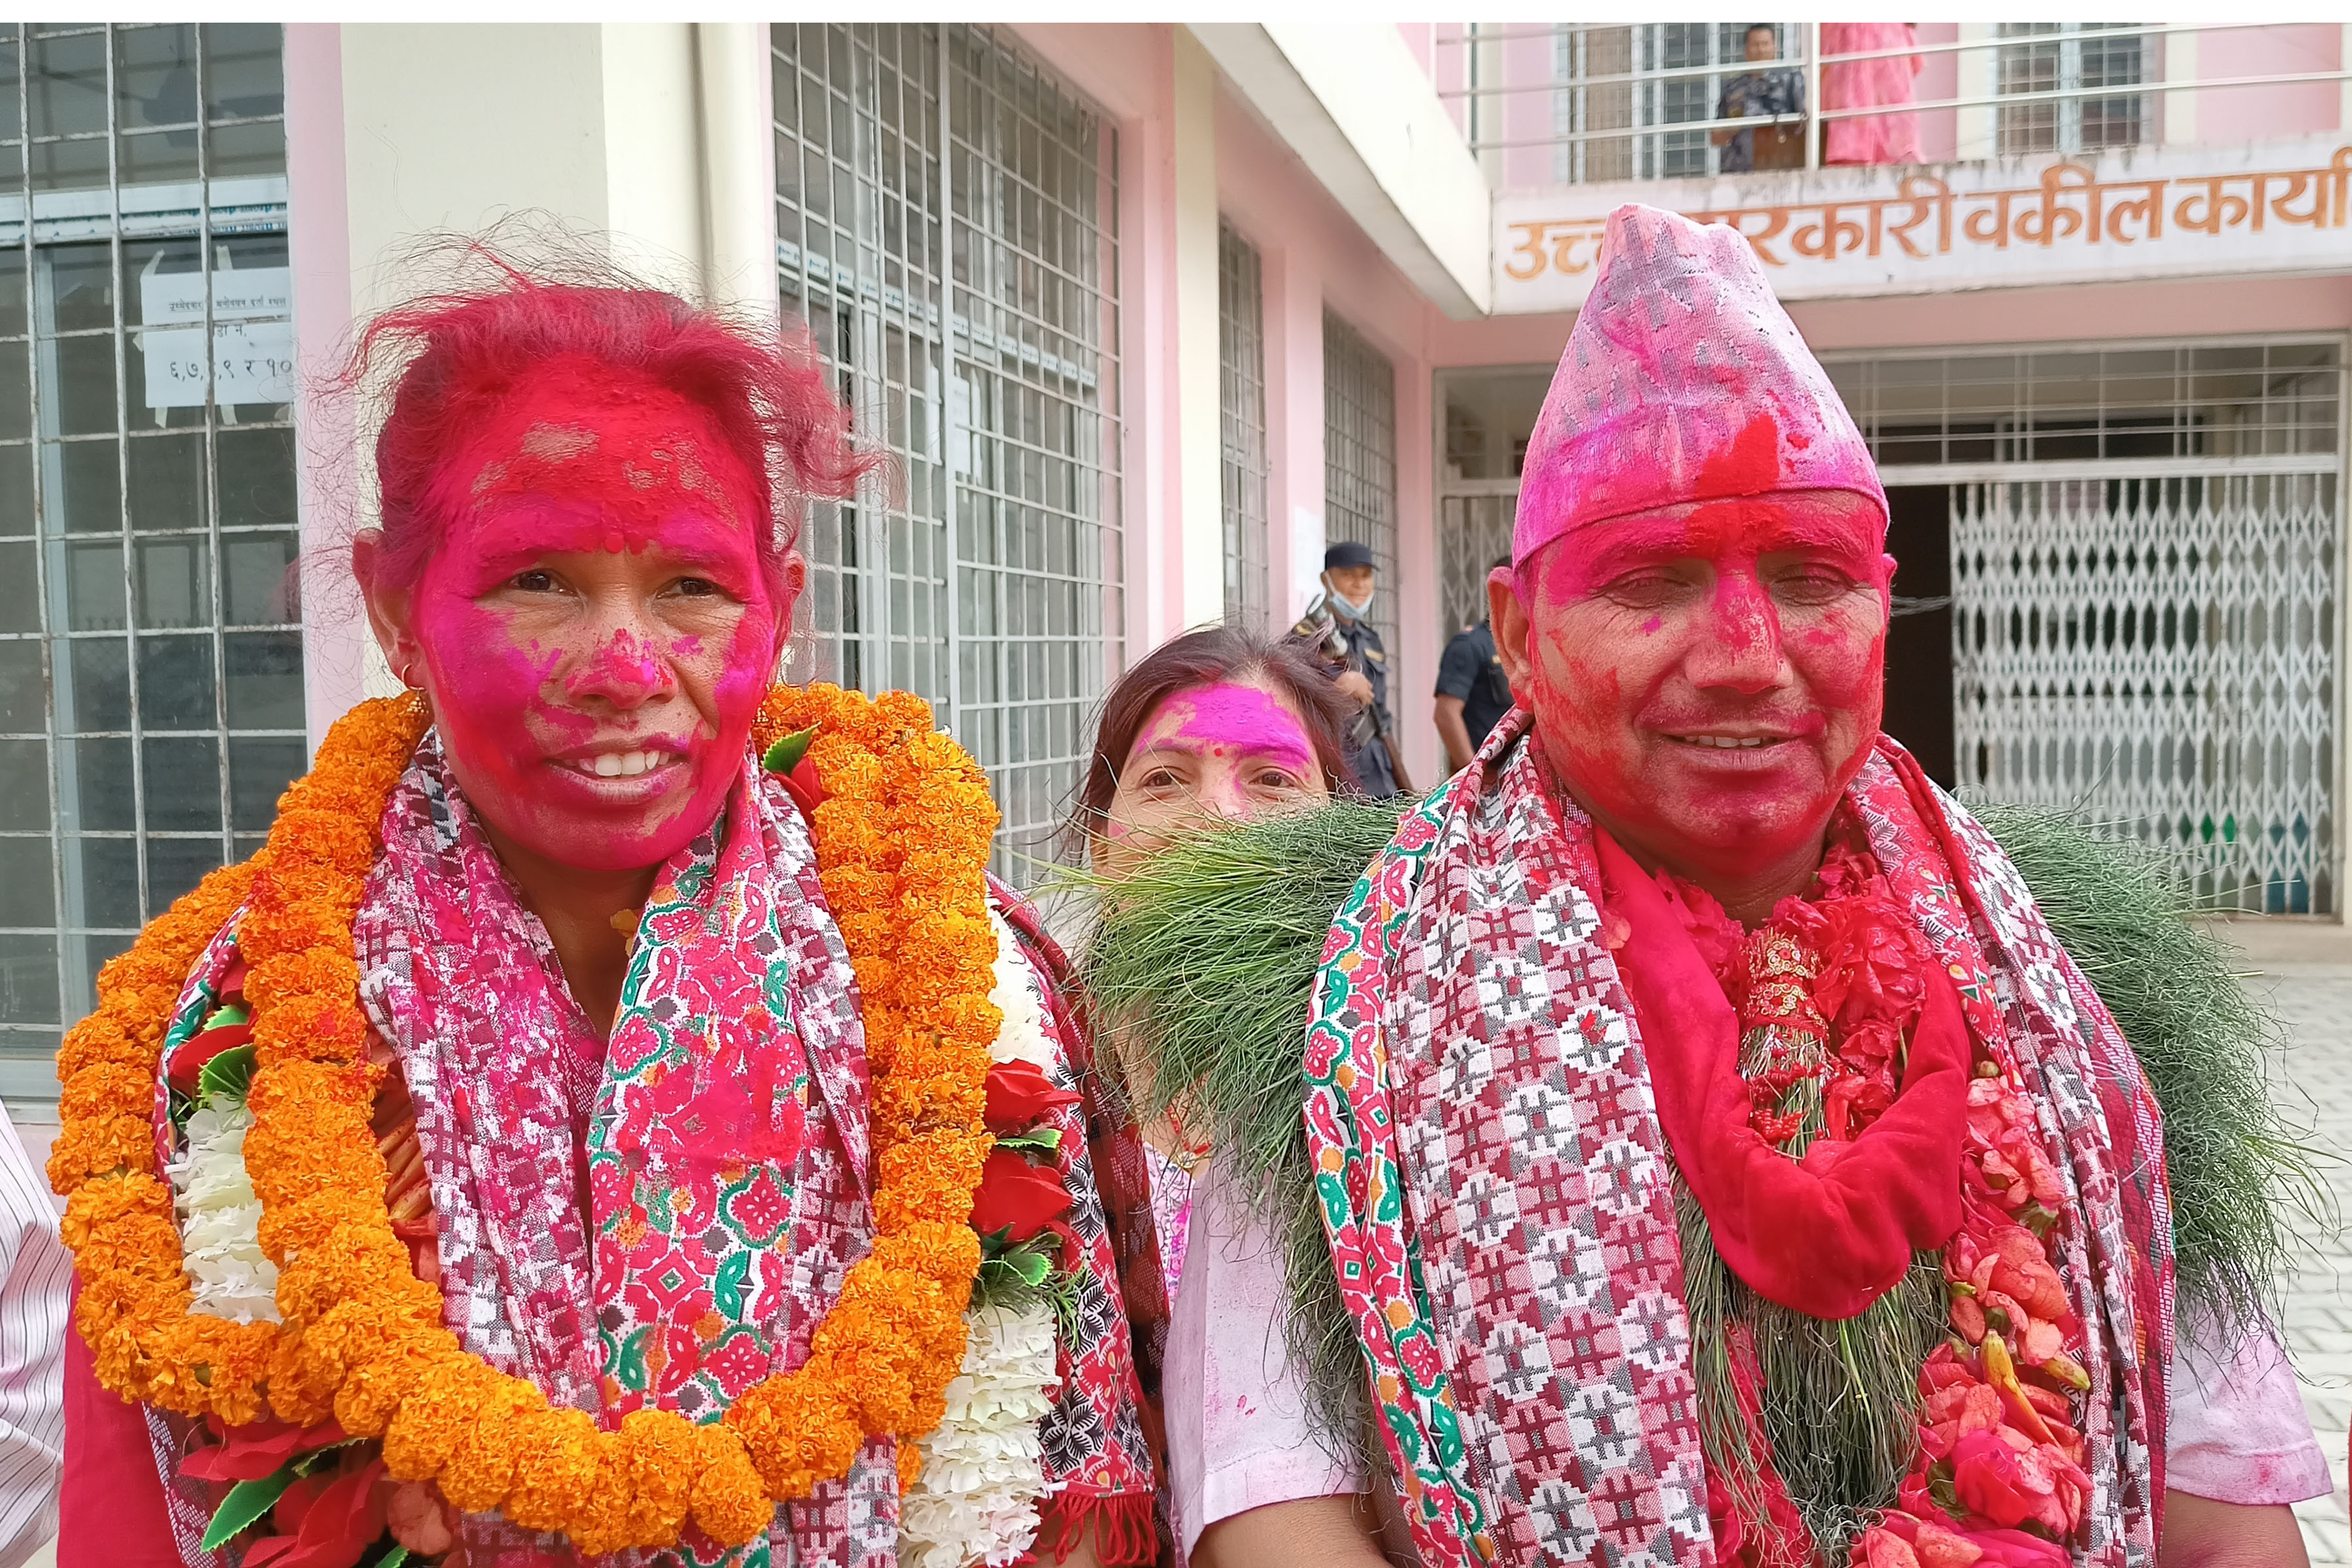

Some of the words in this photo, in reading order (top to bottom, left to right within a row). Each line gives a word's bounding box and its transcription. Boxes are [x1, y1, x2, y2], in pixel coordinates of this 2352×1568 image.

[1690, 174, 1956, 267] रकारी
[1963, 163, 2168, 249] वकील
[2174, 146, 2352, 235] कार्या
[267, 358, 291, 378] १०
